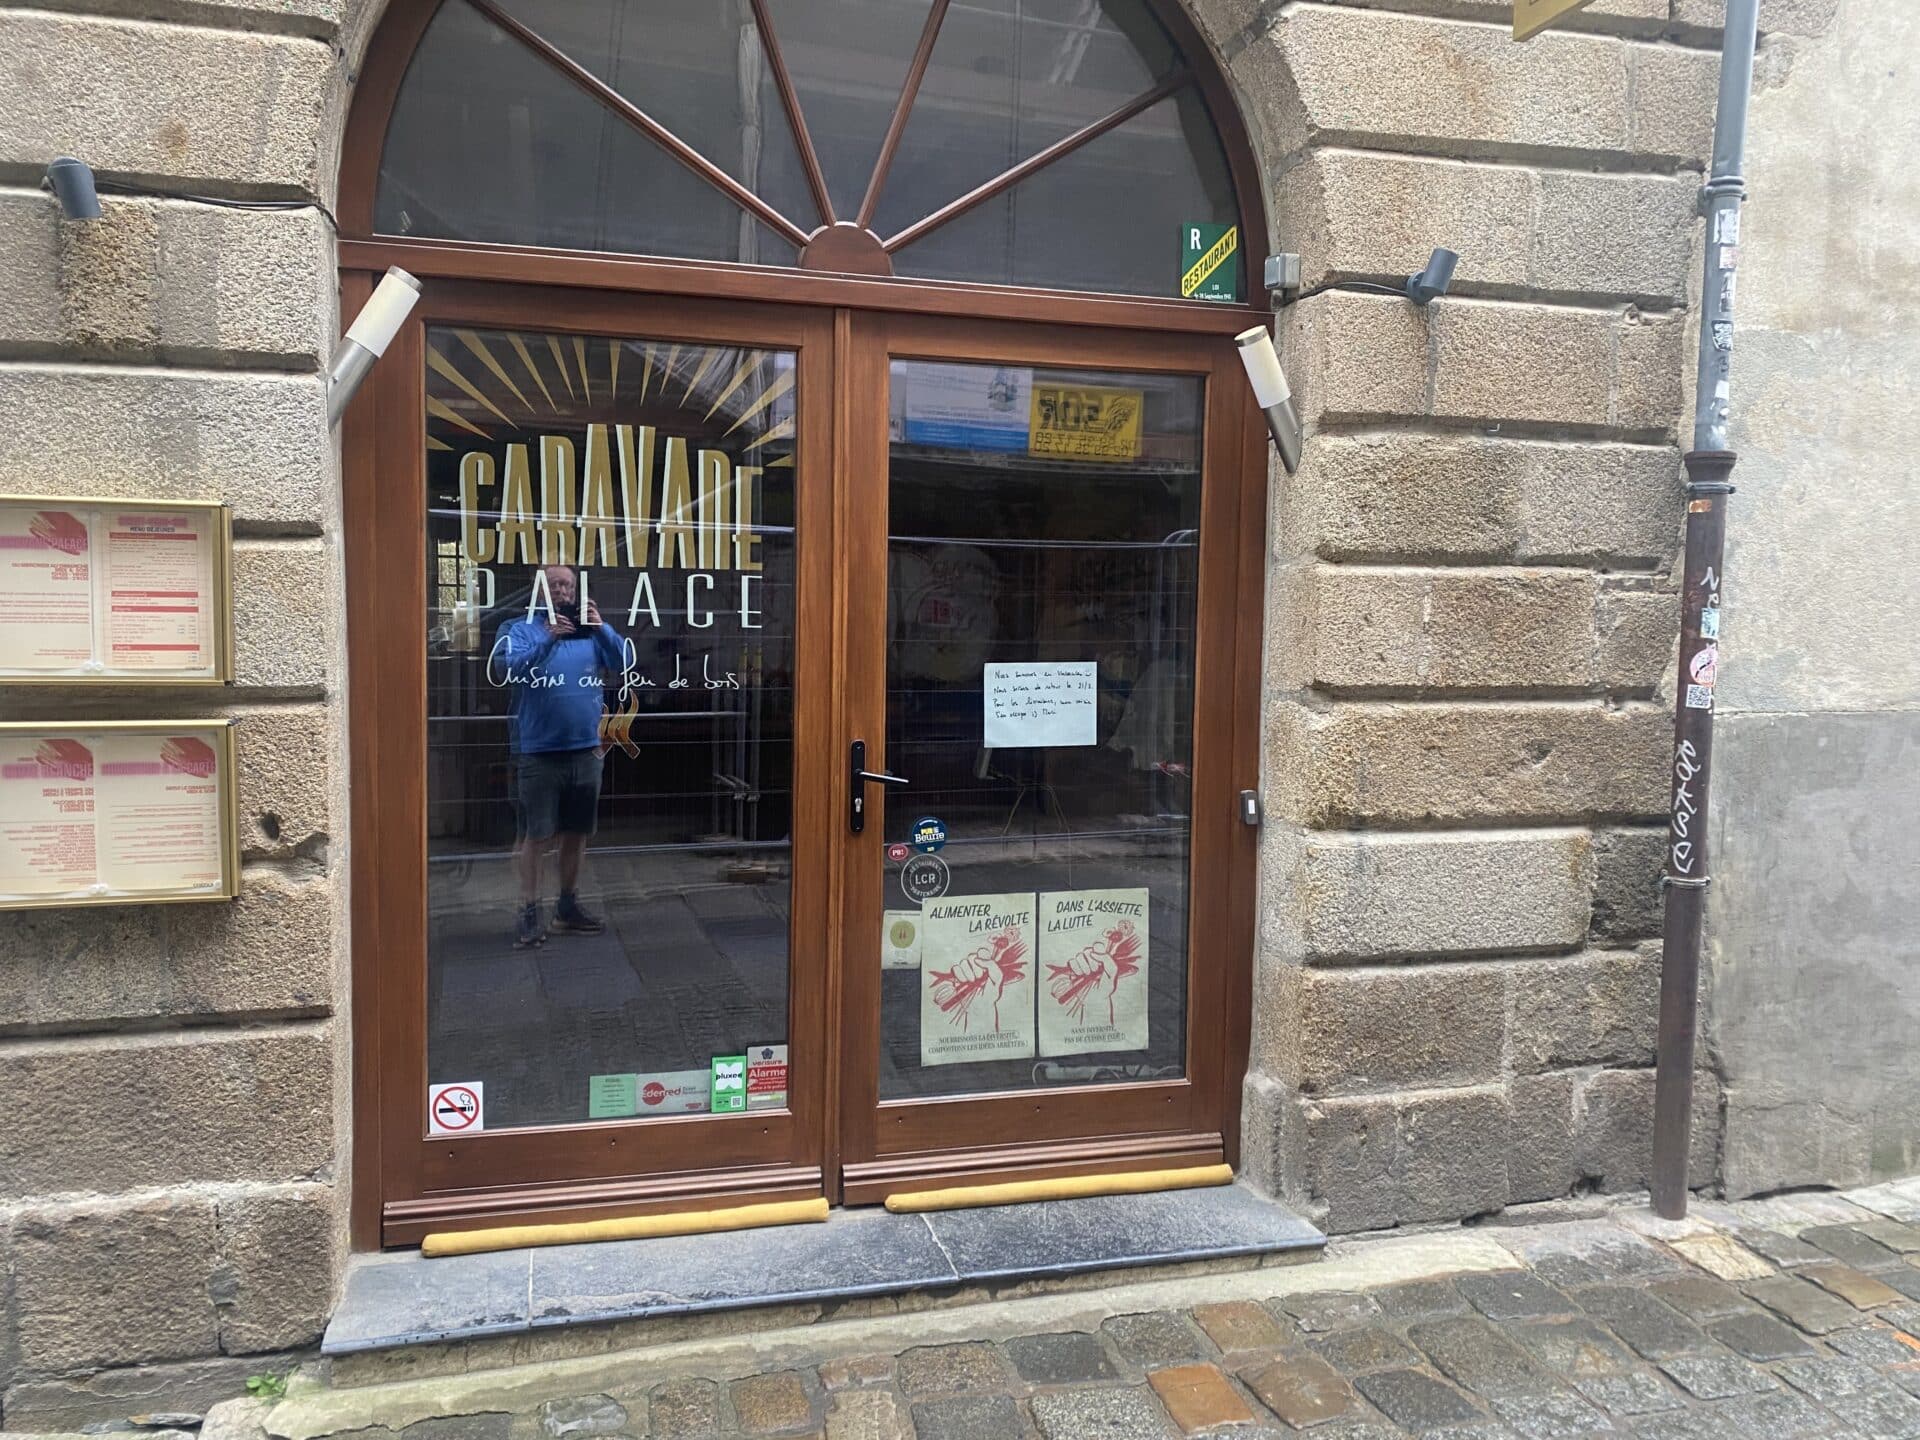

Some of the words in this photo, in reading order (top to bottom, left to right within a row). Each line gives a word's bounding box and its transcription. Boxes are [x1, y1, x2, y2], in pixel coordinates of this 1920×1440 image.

[1190, 227, 1201, 250] R
[1183, 230, 1236, 295] RESTAURANT
[459, 423, 763, 571] CARAVANE
[465, 567, 763, 629] PALACE
[486, 635, 566, 688] Cuisine
[578, 672, 606, 688] au
[617, 637, 657, 702] feu
[668, 653, 690, 689] de
[703, 654, 740, 690] bois
[914, 832, 945, 843] Beurre
[914, 873, 936, 885] LCR
[929, 903, 992, 919] ALIMENTER
[1056, 899, 1084, 914] DANS
[1087, 899, 1143, 917] L'ASSIETTE,
[968, 920, 982, 933] LA
[984, 911, 1030, 931] RÉVOLTE
[1047, 919, 1061, 933] LA
[1062, 914, 1094, 930] LUTTE
[749, 1068, 786, 1078] Alarme
[643, 1086, 681, 1098] Edenred
